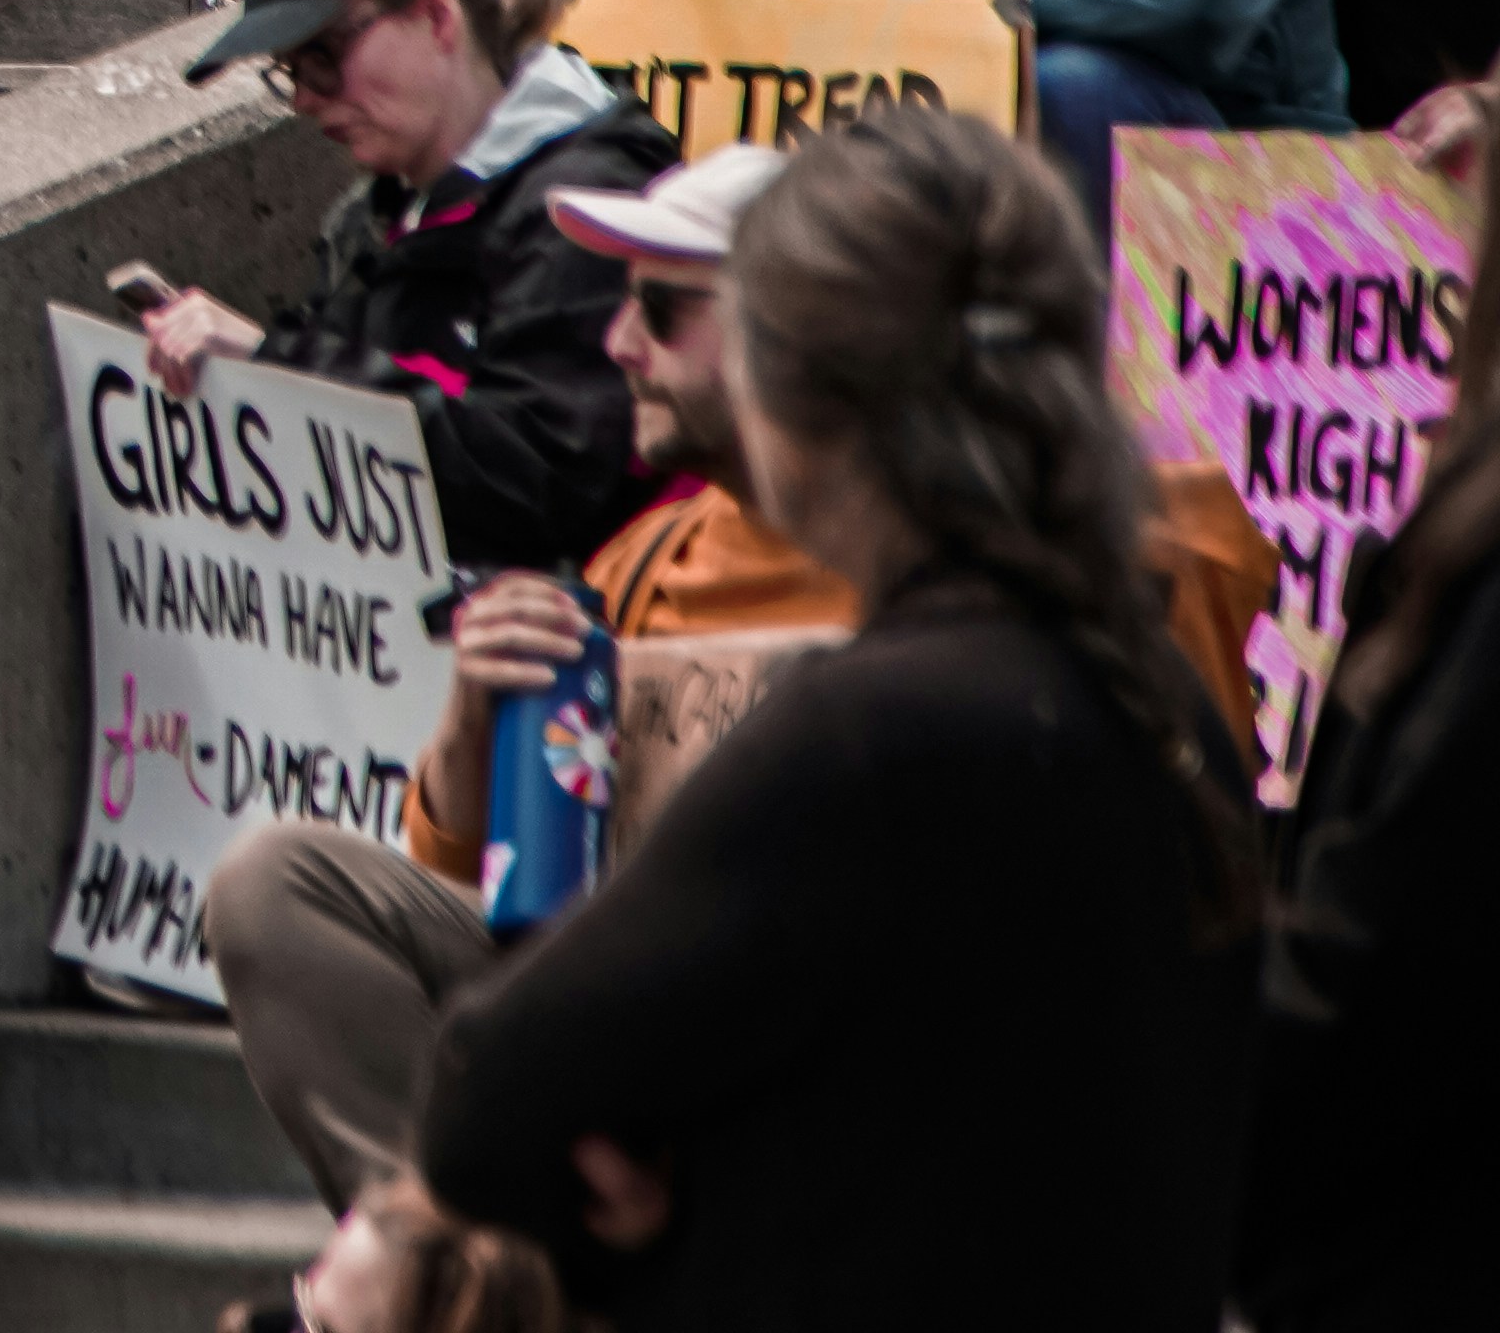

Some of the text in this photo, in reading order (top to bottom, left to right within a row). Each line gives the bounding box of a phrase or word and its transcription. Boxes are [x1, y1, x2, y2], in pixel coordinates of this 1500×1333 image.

[1176, 256, 1470, 379] WOMENS
[88, 362, 434, 578] GIRLS JUST
[107, 533, 399, 687] WANNA HAVE
